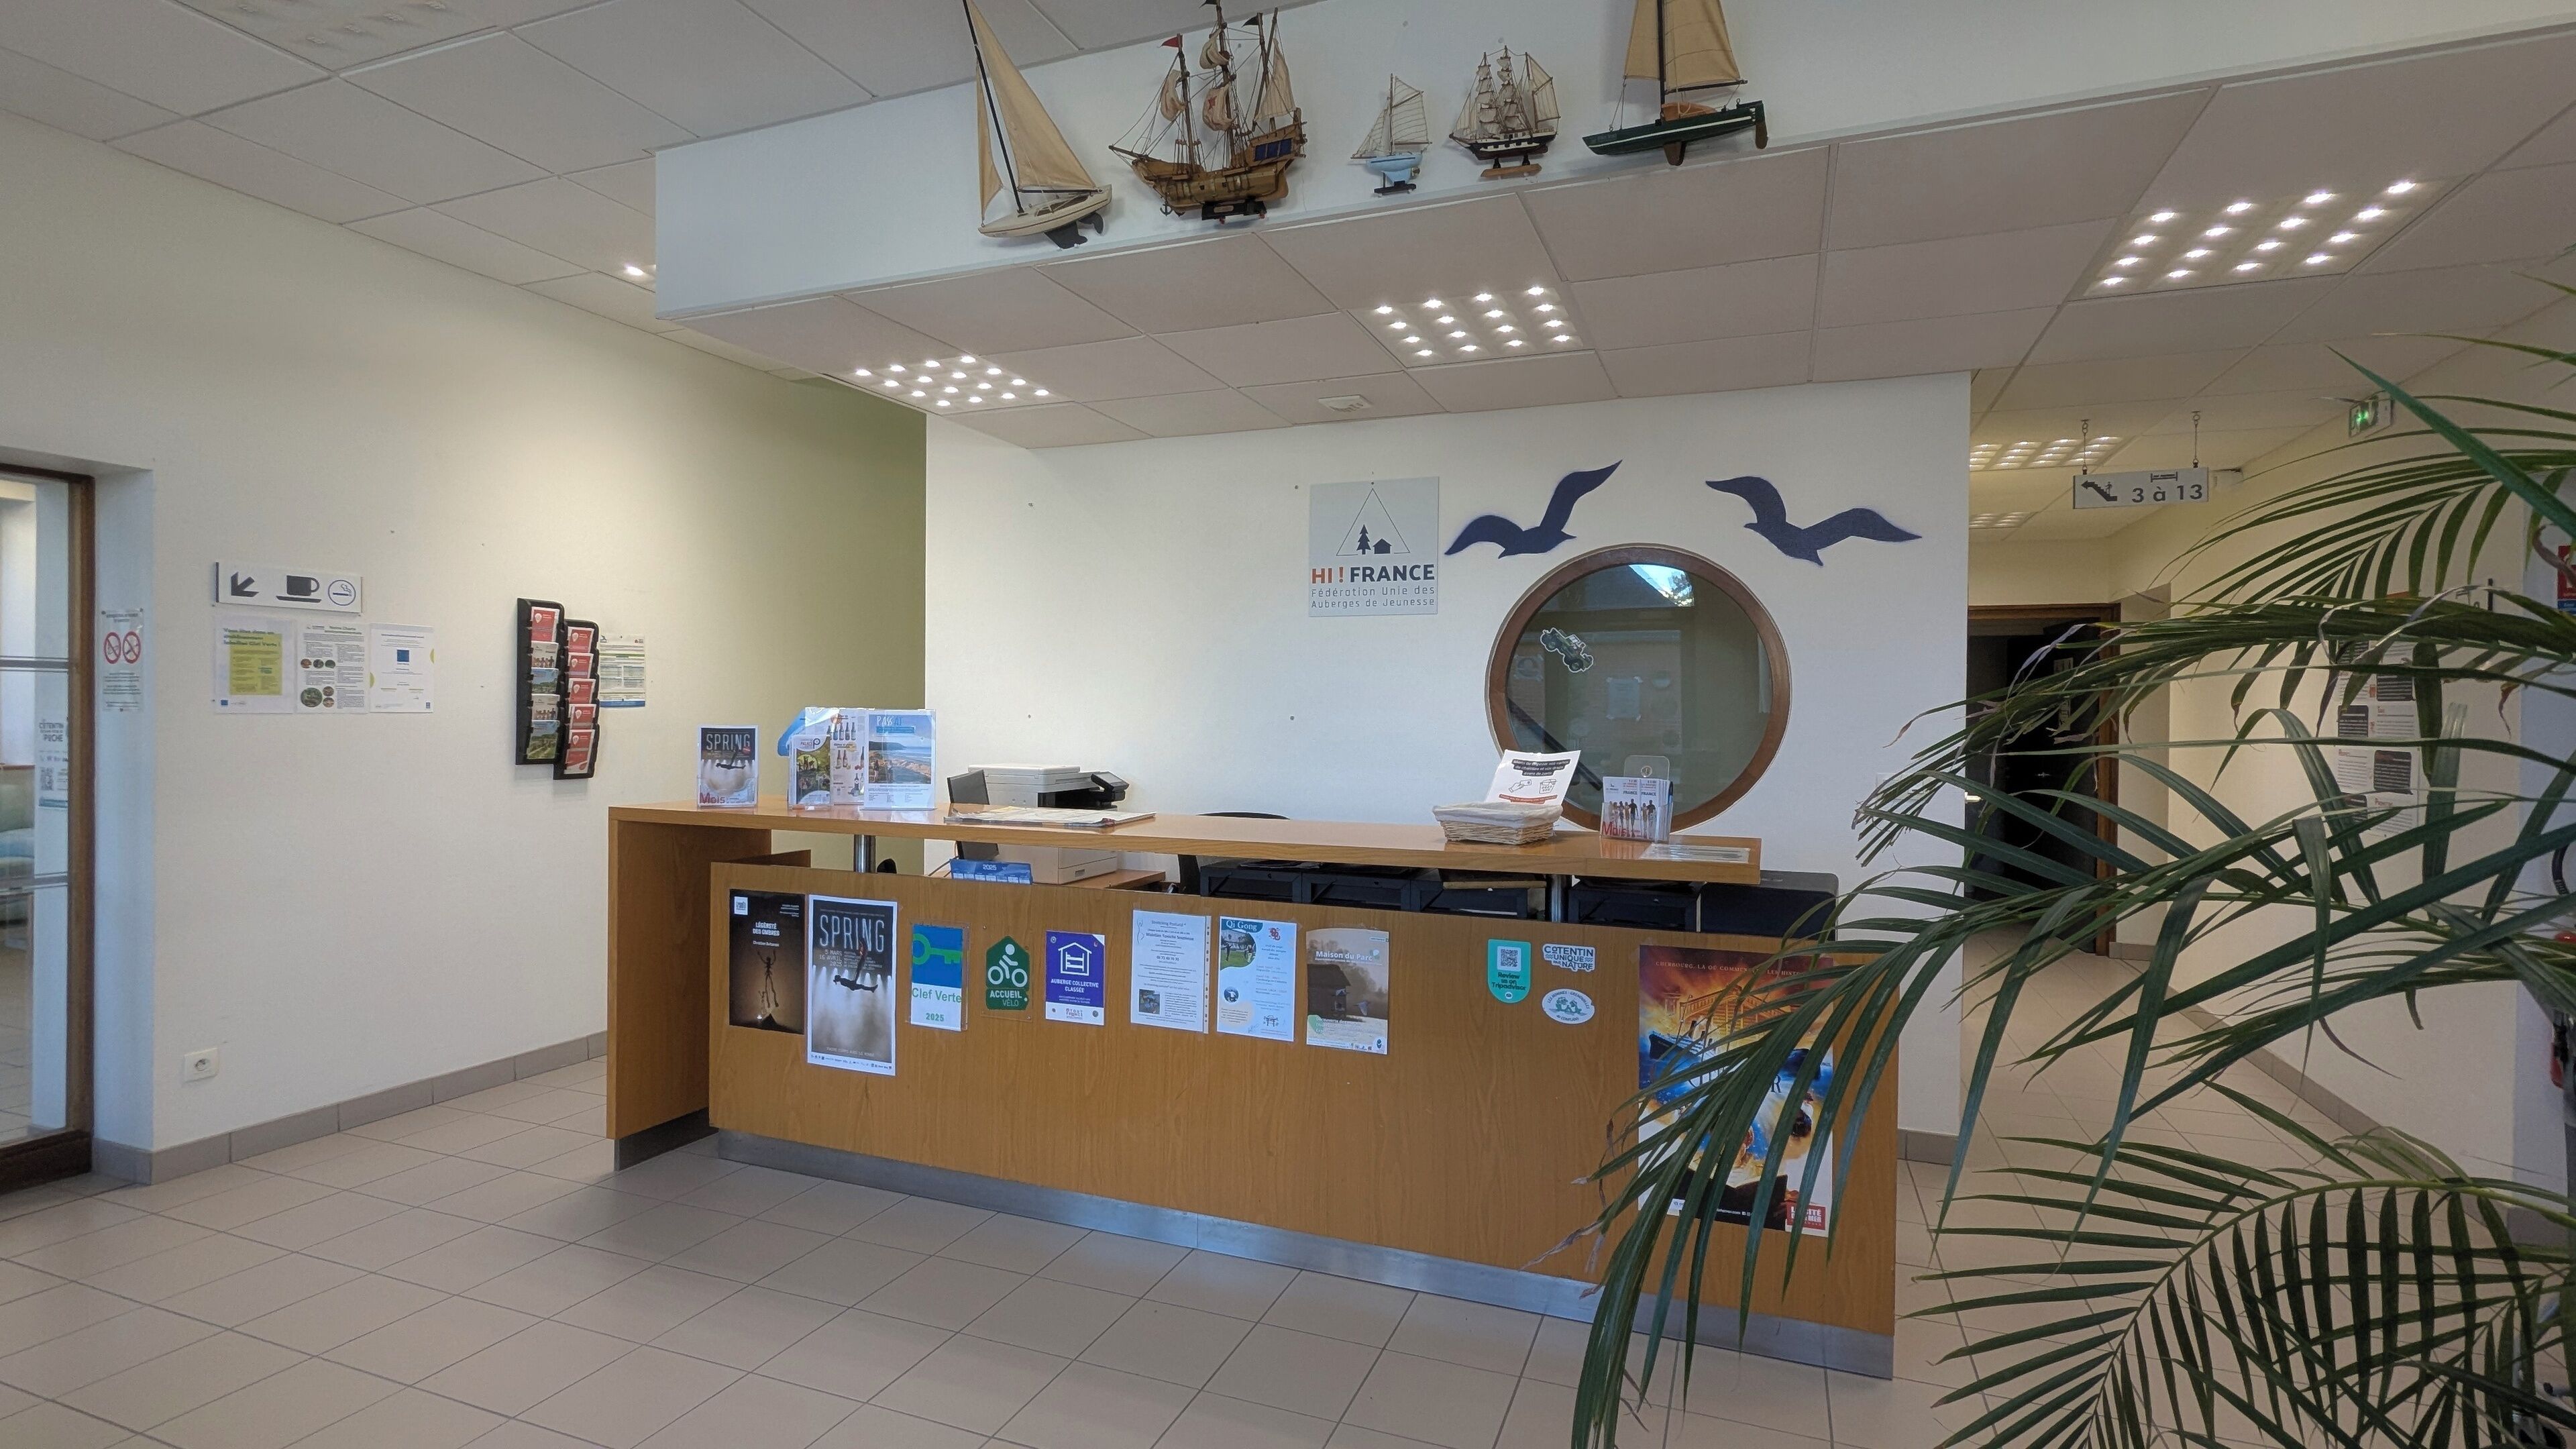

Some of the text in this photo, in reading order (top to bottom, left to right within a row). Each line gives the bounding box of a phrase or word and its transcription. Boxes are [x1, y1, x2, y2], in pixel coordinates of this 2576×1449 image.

[2132, 484, 2203, 502] 3 à 13
[1311, 568, 1333, 584] HI
[1350, 564, 1436, 583] FRANCE
[1311, 585, 1436, 598] Fédération Unie des
[1311, 598, 1435, 609] Auberges de Jeunesse
[706, 733, 751, 751] SPRING
[1226, 920, 1257, 931] Qi Gong
[820, 914, 885, 953] SPRING
[1316, 951, 1343, 959] Maison
[1356, 953, 1373, 961] Parc
[1544, 946, 1594, 957] COTENTIN
[1554, 954, 1585, 962] UNIQUE
[1562, 961, 1593, 971] NATURE
[1072, 980, 1099, 988] COLLECTIVE
[1491, 982, 1527, 991] Tripadvisor
[912, 987, 962, 1003] Clef Verte
[989, 989, 1022, 999] ACCUEIL
[1002, 998, 1019, 1007] VÉLO
[926, 1012, 945, 1022] 2025
